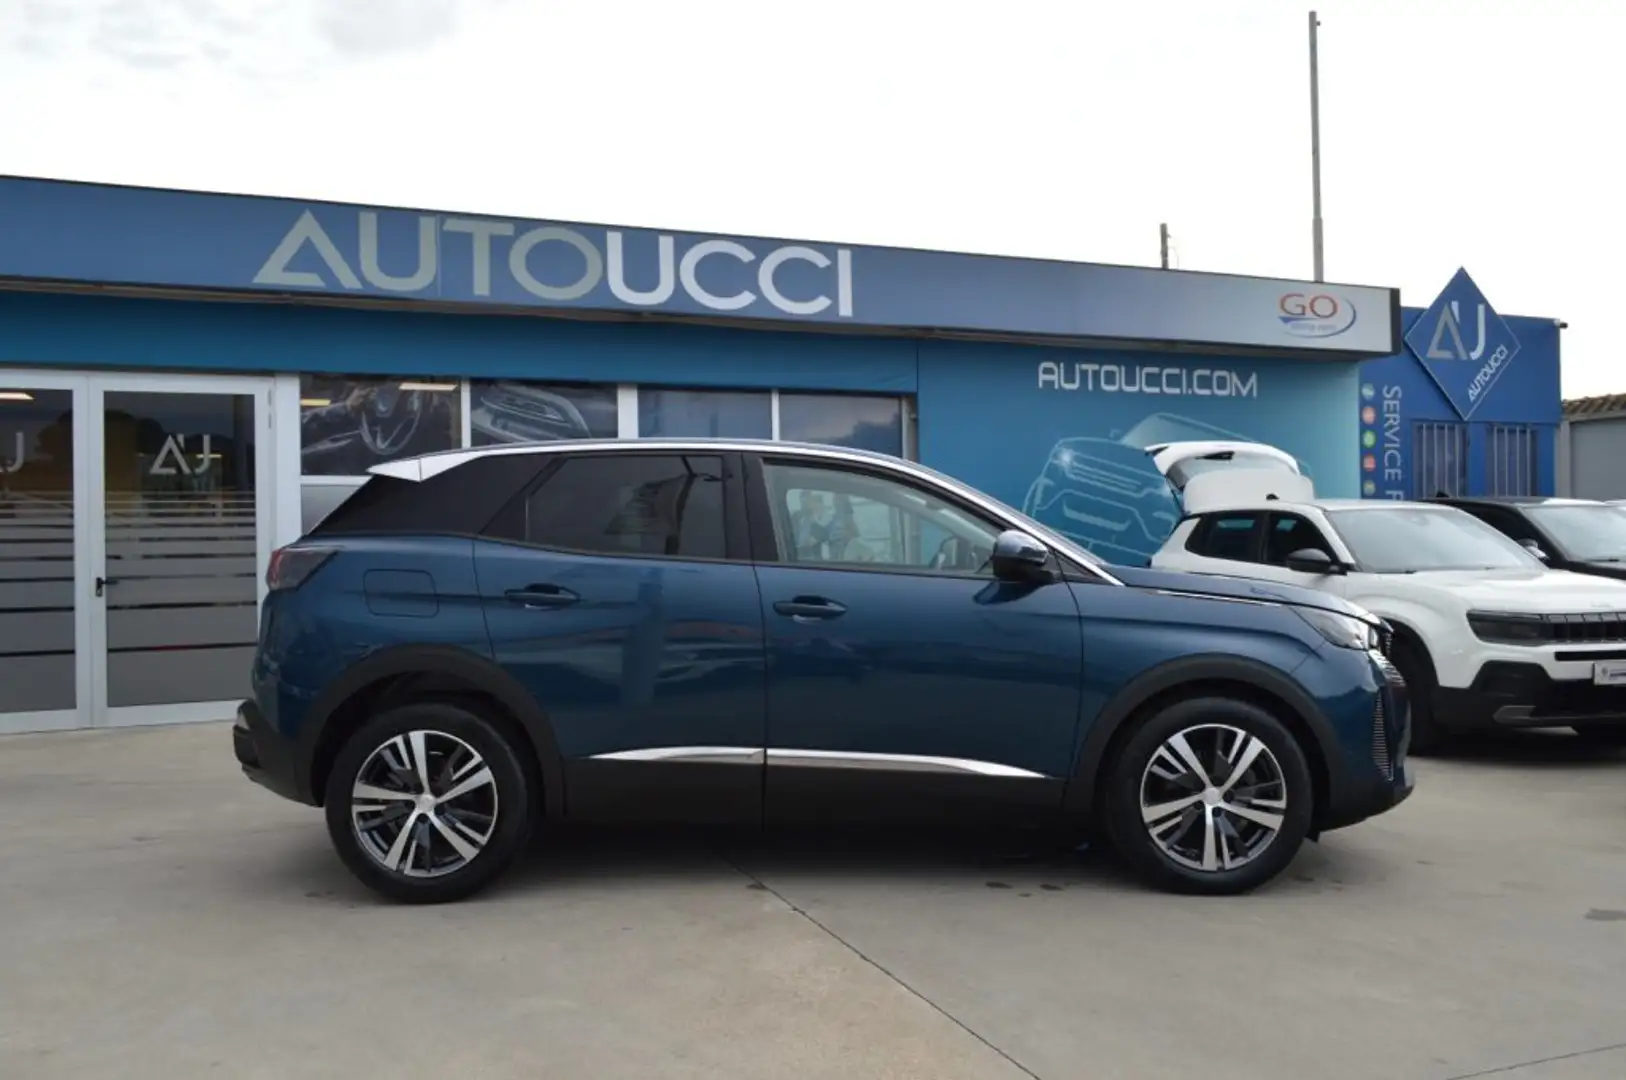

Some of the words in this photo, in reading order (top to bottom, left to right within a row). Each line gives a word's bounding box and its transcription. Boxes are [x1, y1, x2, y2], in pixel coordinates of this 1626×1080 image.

[252, 208, 853, 317] AUTOUCCI
[1280, 293, 1337, 318] GO
[1038, 362, 1258, 398] AUTOUCCI.COM
[1467, 343, 1509, 402] AUTOUCCI
[1382, 385, 1402, 480] SERVICE
